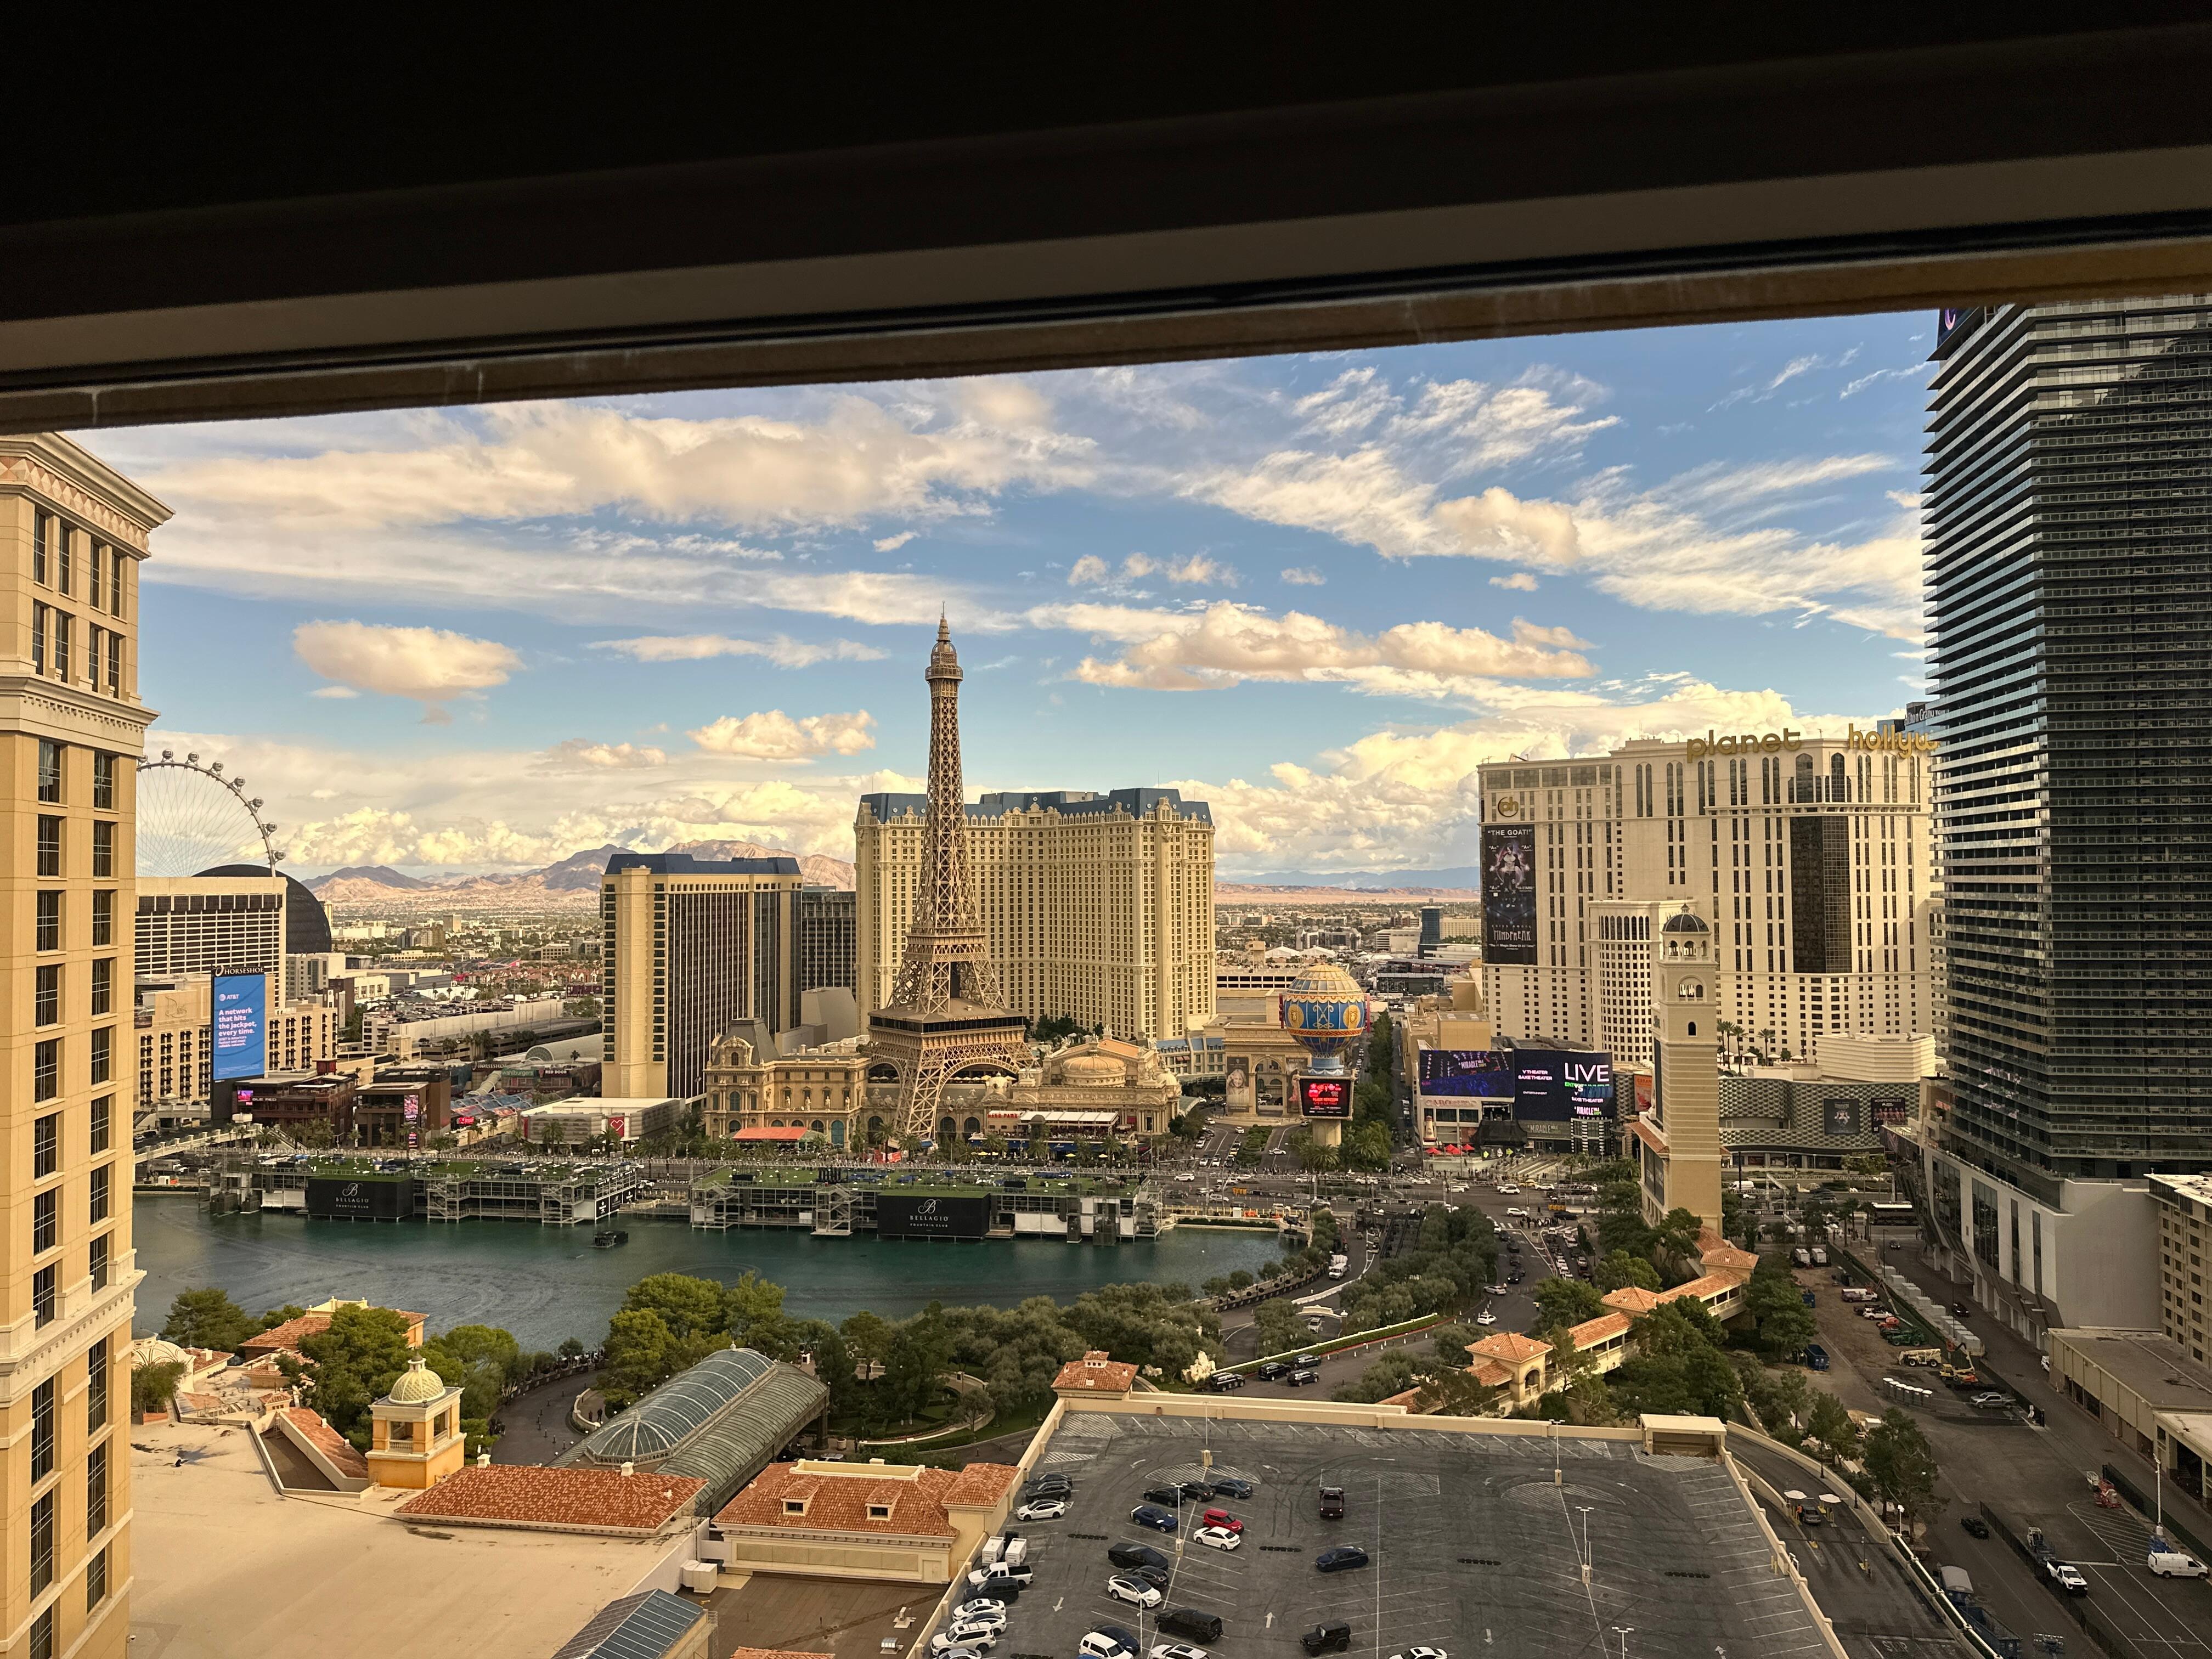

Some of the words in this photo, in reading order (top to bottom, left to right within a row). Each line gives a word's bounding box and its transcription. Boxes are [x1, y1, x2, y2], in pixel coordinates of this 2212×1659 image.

[1904, 712, 1919, 726] Hilton
[1687, 727, 1801, 763] planet
[1848, 723, 1940, 759] hollyw
[1494, 930, 1531, 941] MINDFREAK
[224, 967, 264, 975] HORSESHOE
[230, 1021, 257, 1030] jackpot,
[1461, 1060, 1479, 1069] MIRACLE
[1565, 1062, 1610, 1082] LIVE
[1576, 1106, 1594, 1115] MIRACLE
[1530, 1124, 1551, 1134] MIRACLE
